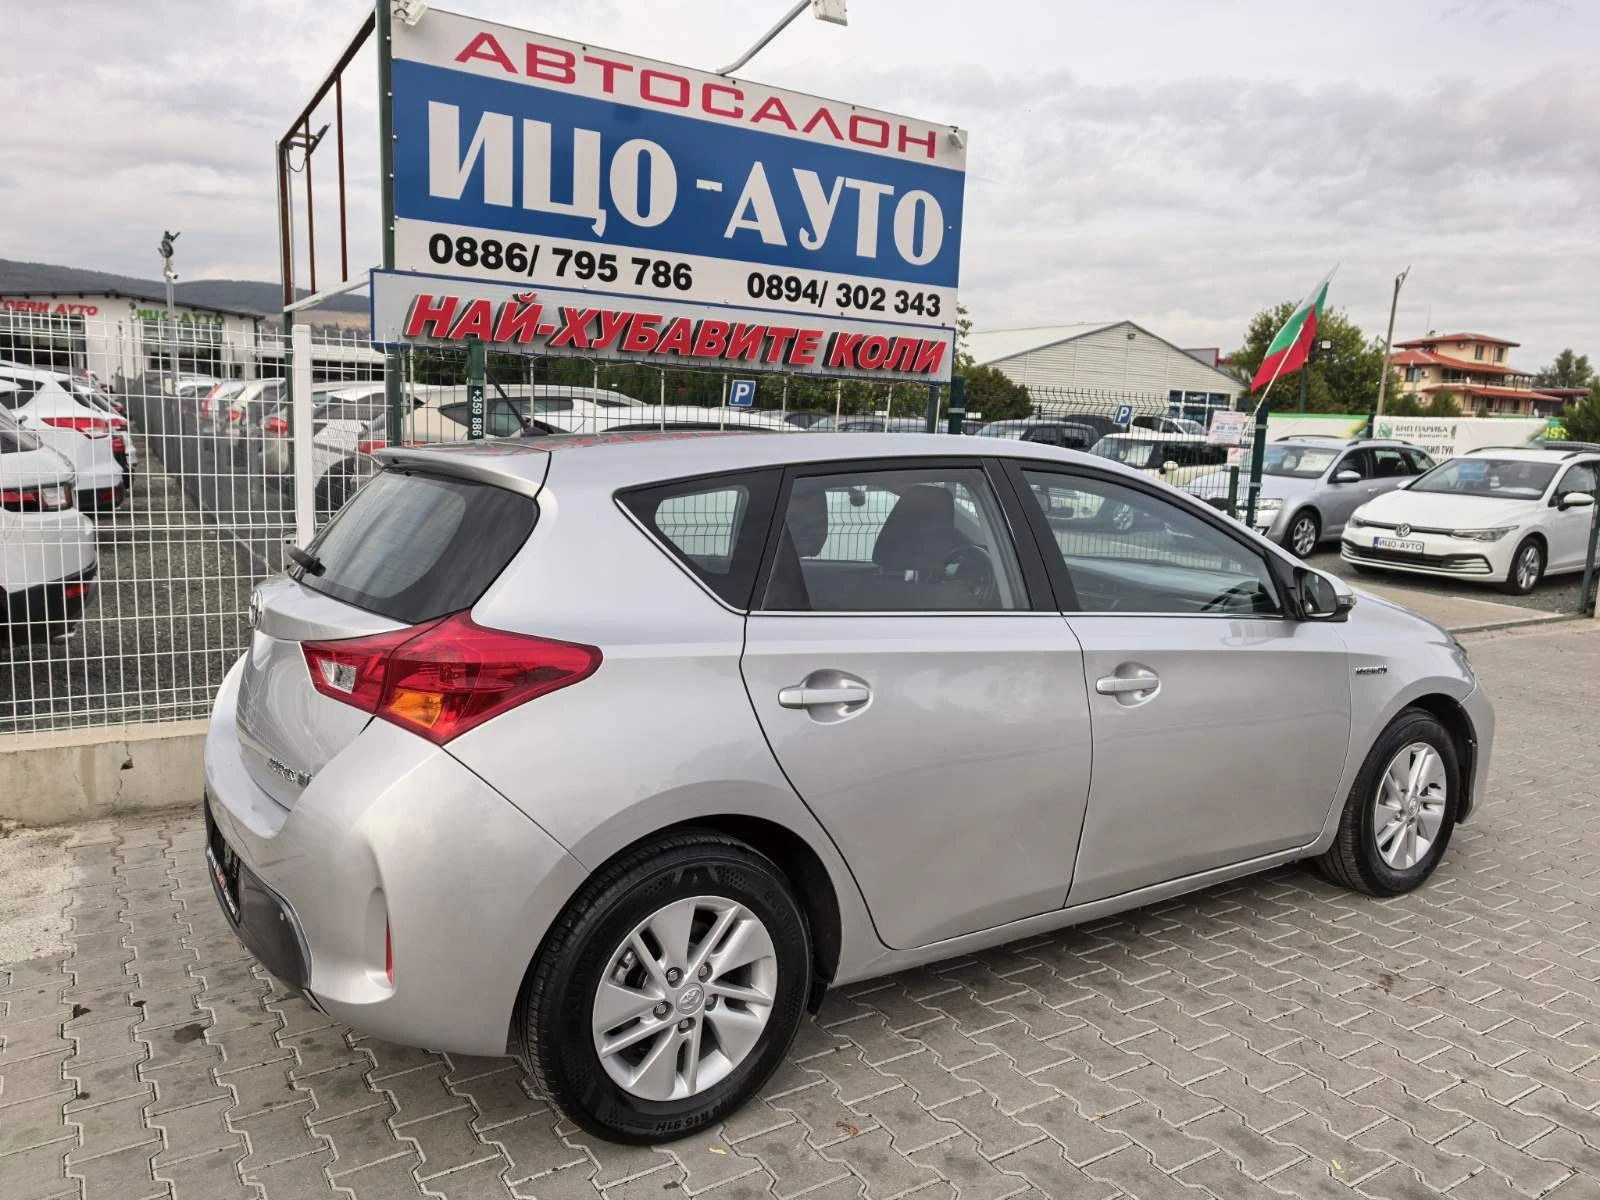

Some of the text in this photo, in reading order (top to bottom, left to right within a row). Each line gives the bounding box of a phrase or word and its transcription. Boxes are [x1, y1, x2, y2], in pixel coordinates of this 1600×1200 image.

[455, 32, 937, 158] АВТОСАЛОН
[428, 233, 693, 291] 0886/ 795 786
[747, 272, 941, 317] 0894/ 302 343
[404, 291, 947, 373] НАЙ-ХУБАВИТЕ КОЛИ
[472, 389, 483, 436] +359 886
